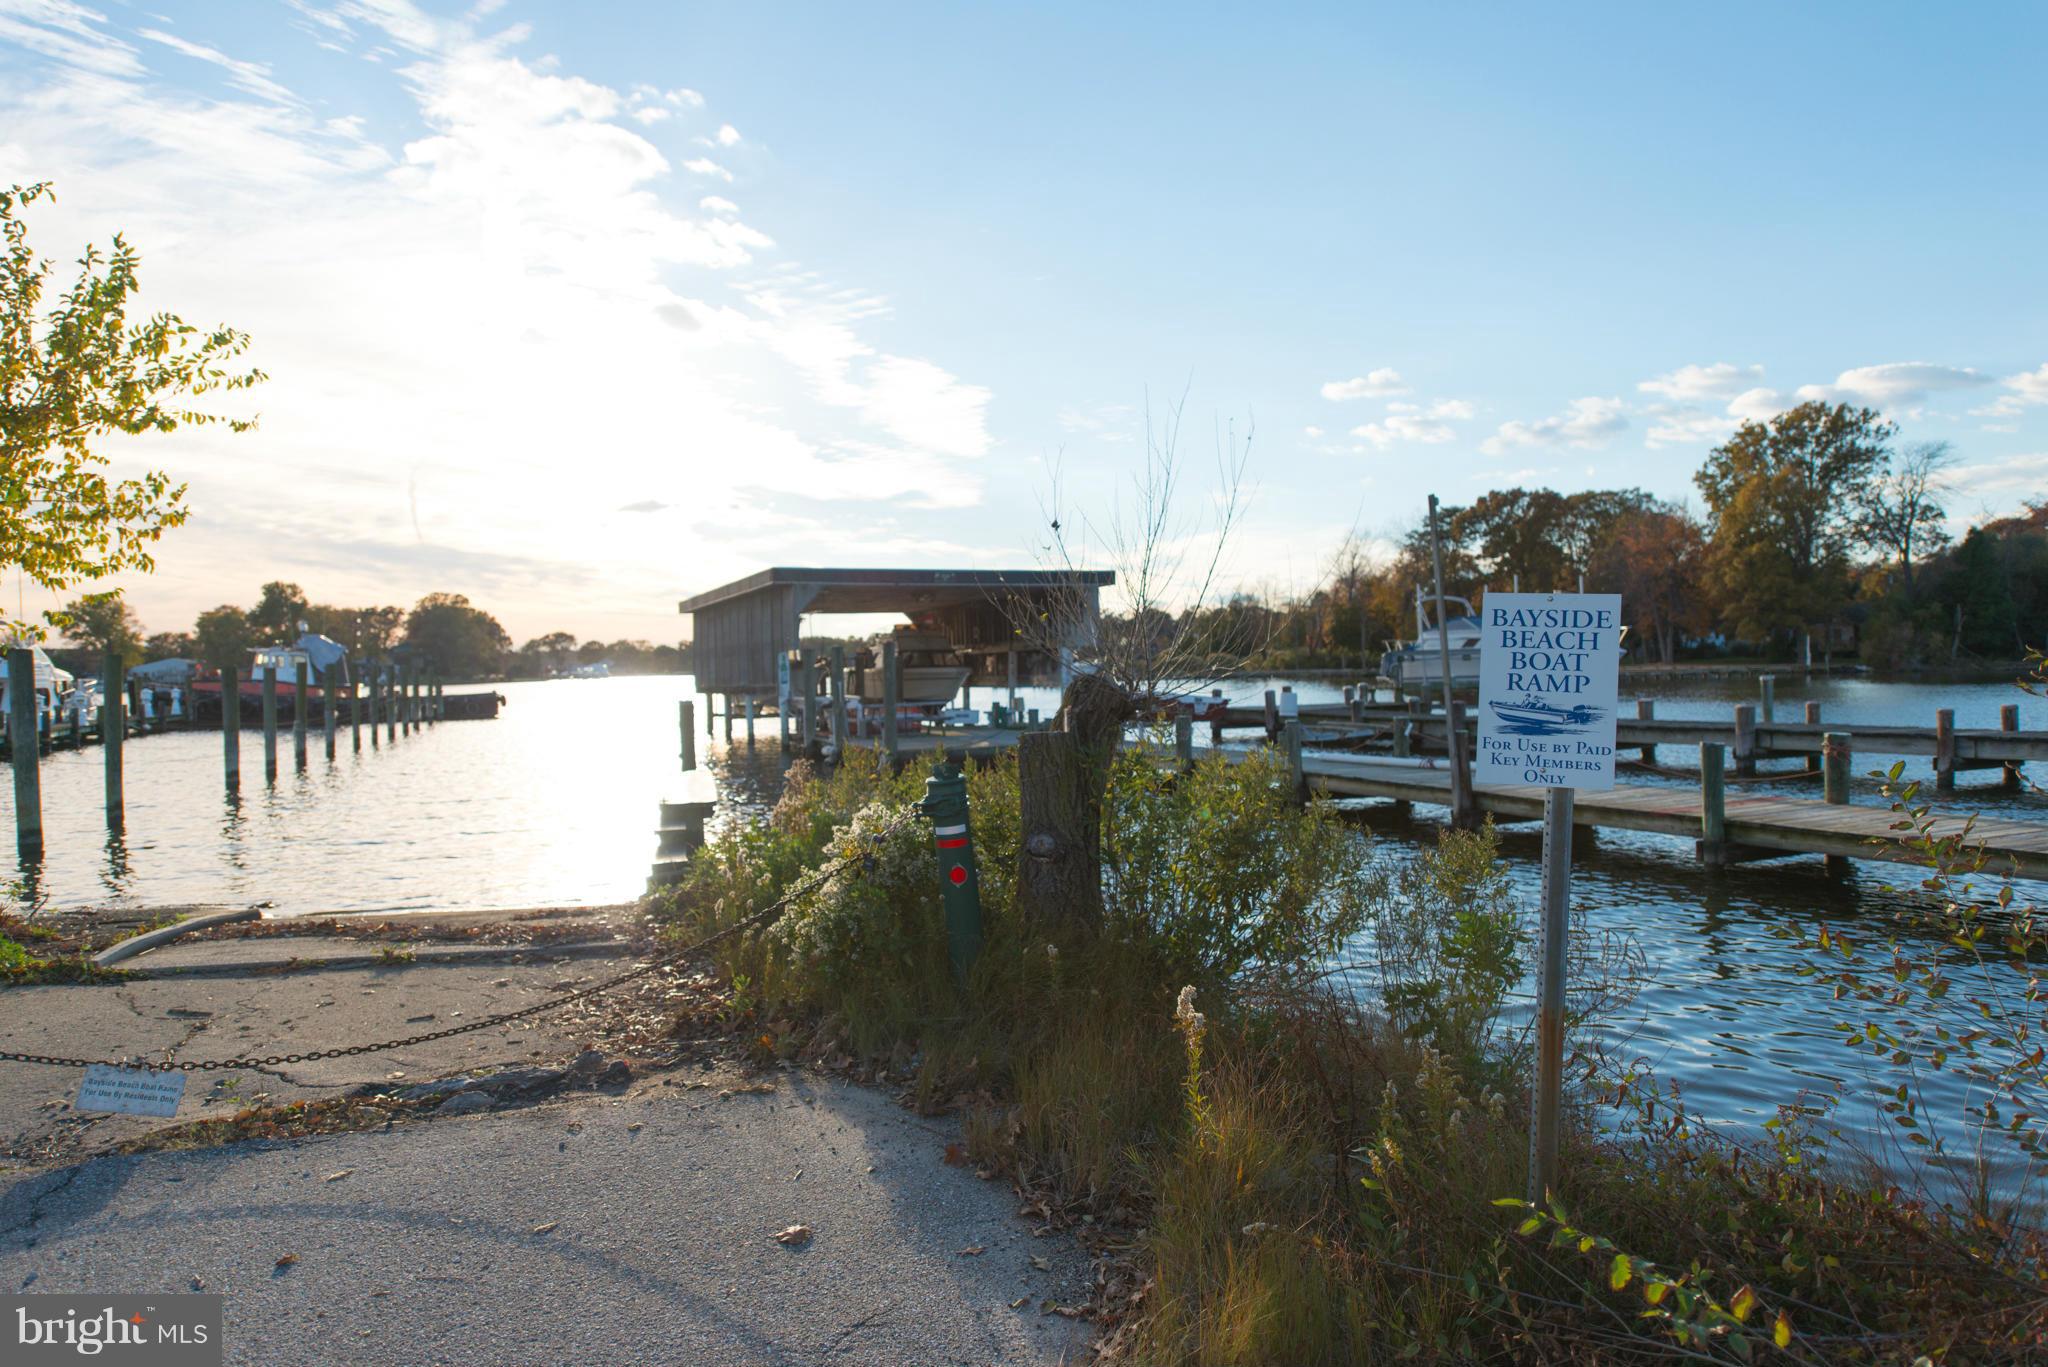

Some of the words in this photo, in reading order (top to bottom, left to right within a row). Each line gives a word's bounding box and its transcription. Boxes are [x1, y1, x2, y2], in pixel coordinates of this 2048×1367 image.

[1491, 608, 1613, 629] BAYSIDE
[1500, 630, 1600, 650] BEACH
[1511, 651, 1589, 672] BOAT
[1506, 672, 1591, 693] RAMP
[1482, 736, 1511, 750] FOR
[1517, 738, 1547, 753] USE
[1576, 741, 1612, 756] PAID
[1491, 752, 1520, 766] KEY
[1525, 754, 1601, 771] MEMBERS
[1524, 769, 1566, 785] ONLY
[84, 1088, 97, 1096] For
[159, 1094, 176, 1105] Only
